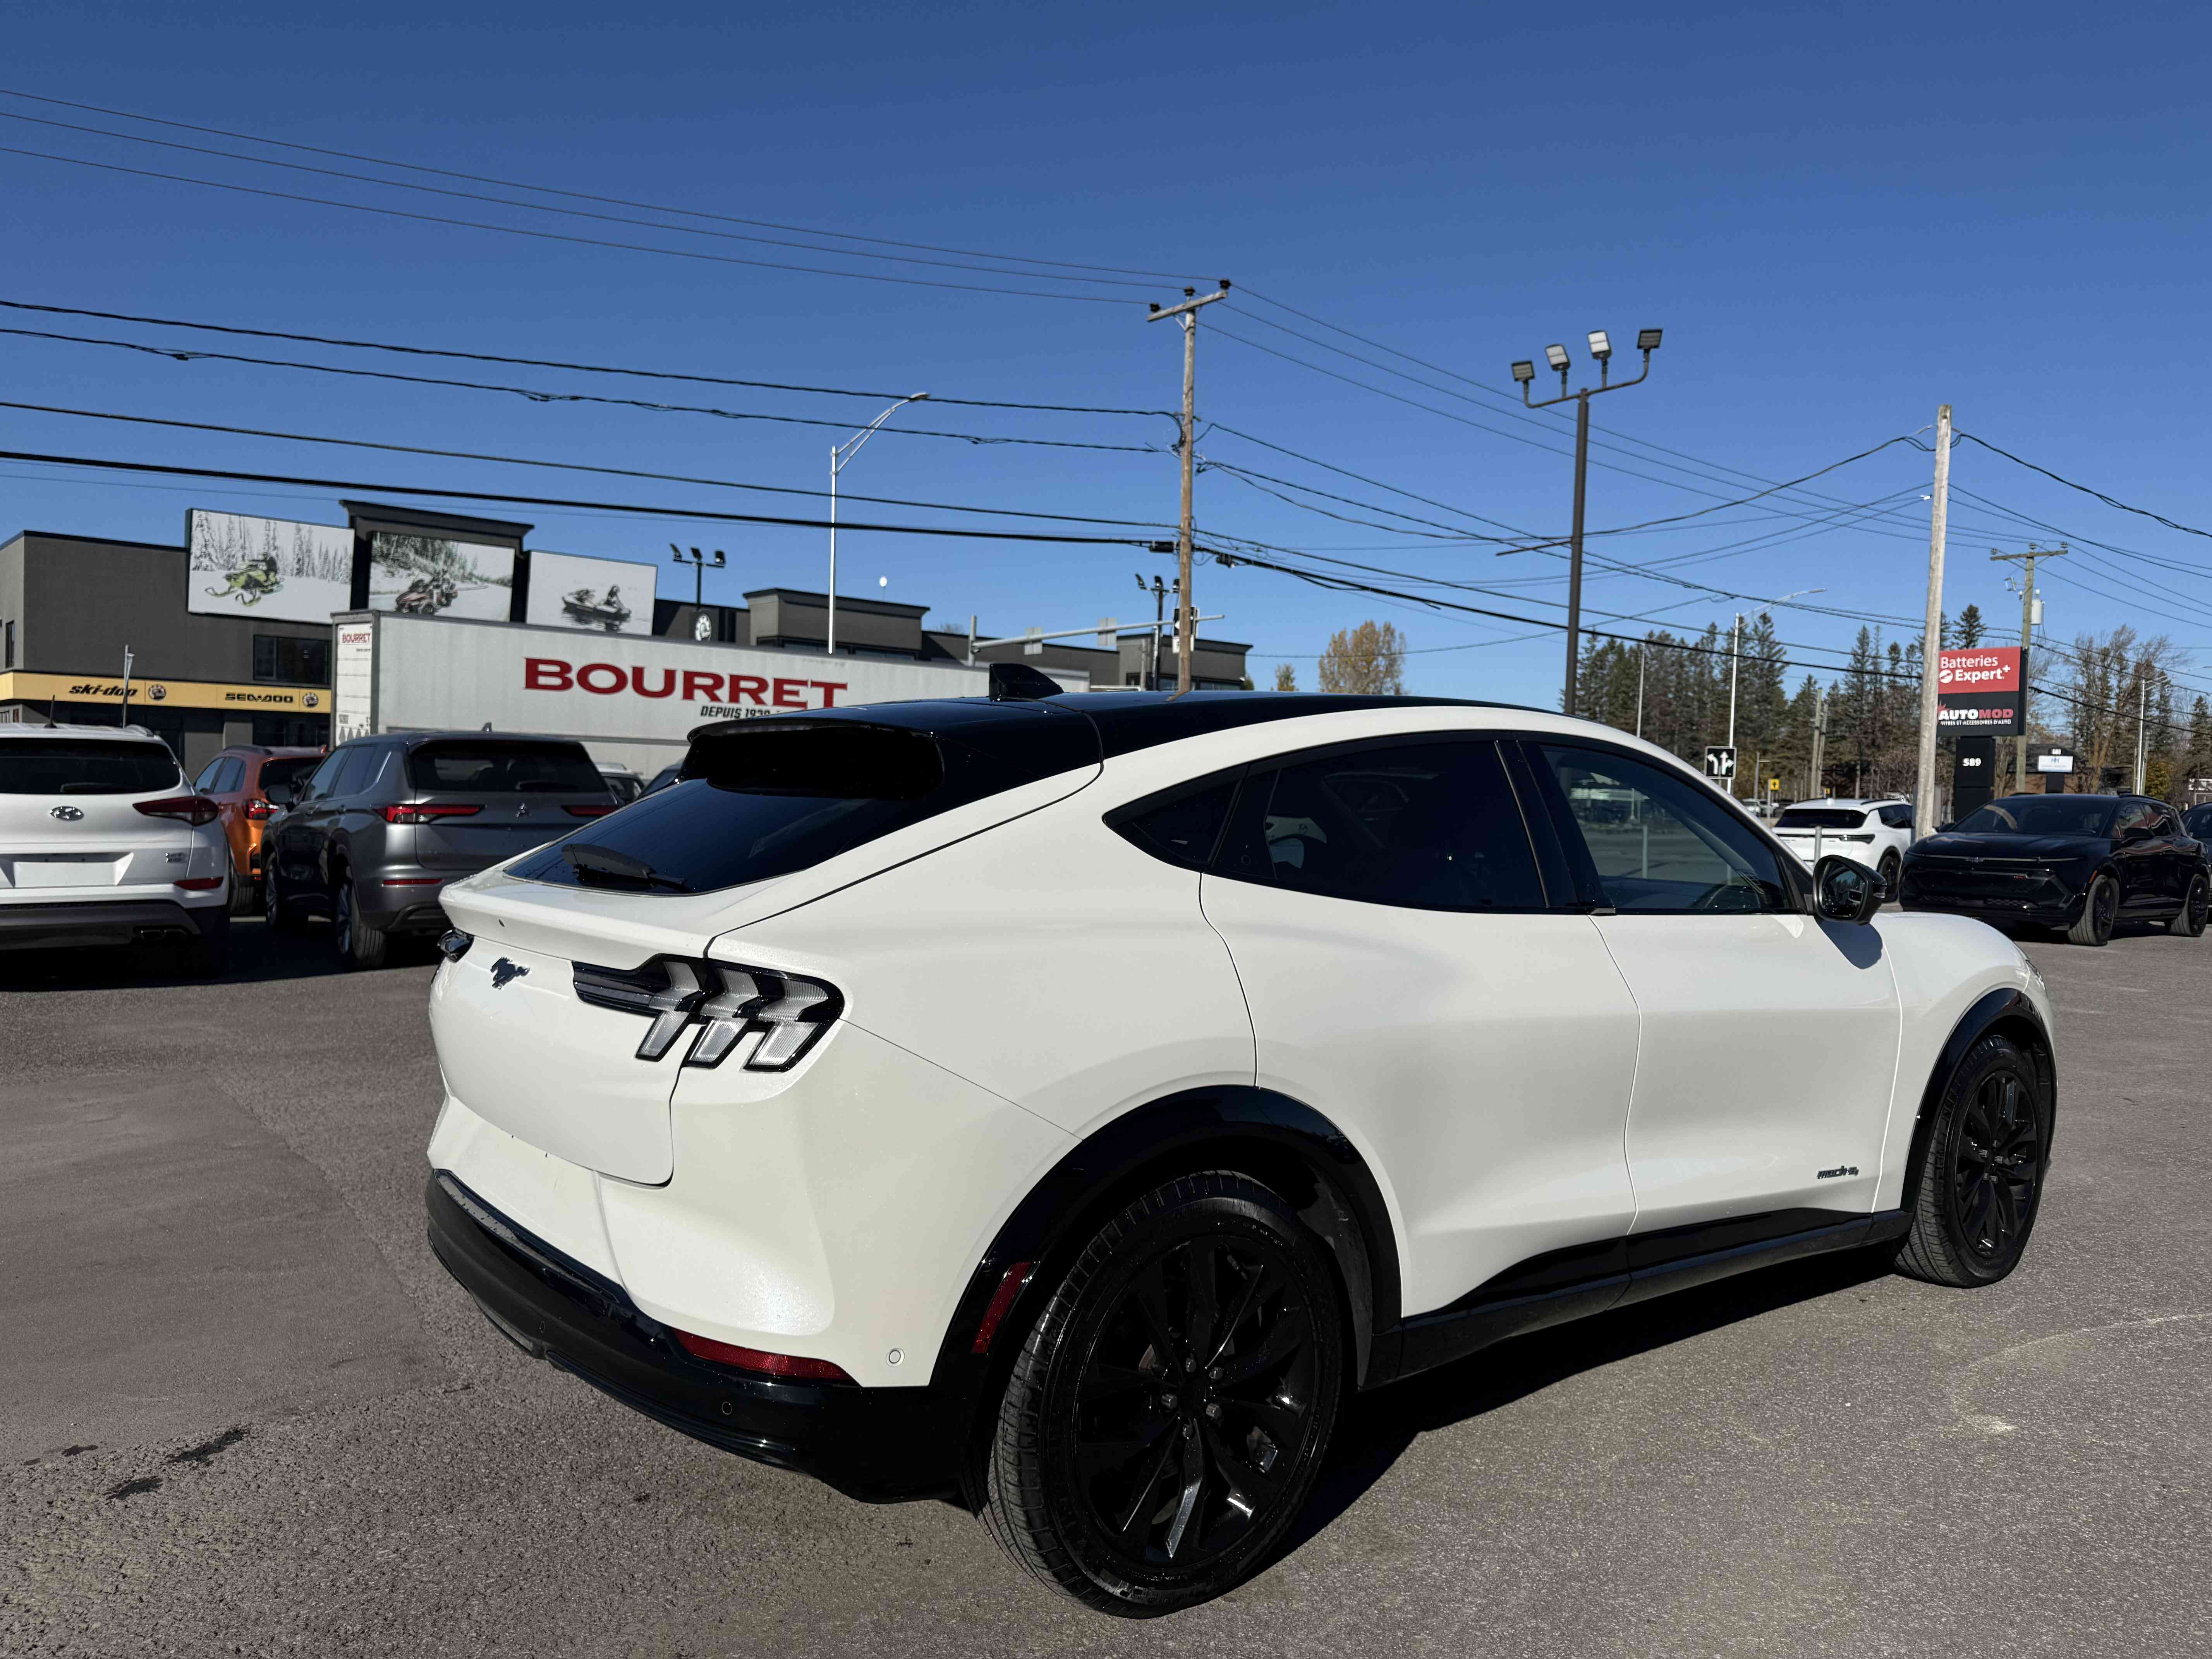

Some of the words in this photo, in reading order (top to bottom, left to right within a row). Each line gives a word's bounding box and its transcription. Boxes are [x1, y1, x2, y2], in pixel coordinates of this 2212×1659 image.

[1941, 655, 1998, 669] Batteries
[524, 657, 848, 710] BOURRET
[701, 705, 742, 719] DEPUIS
[1939, 709, 2014, 720] AUTOMOD
[1961, 758, 1981, 766] 589
